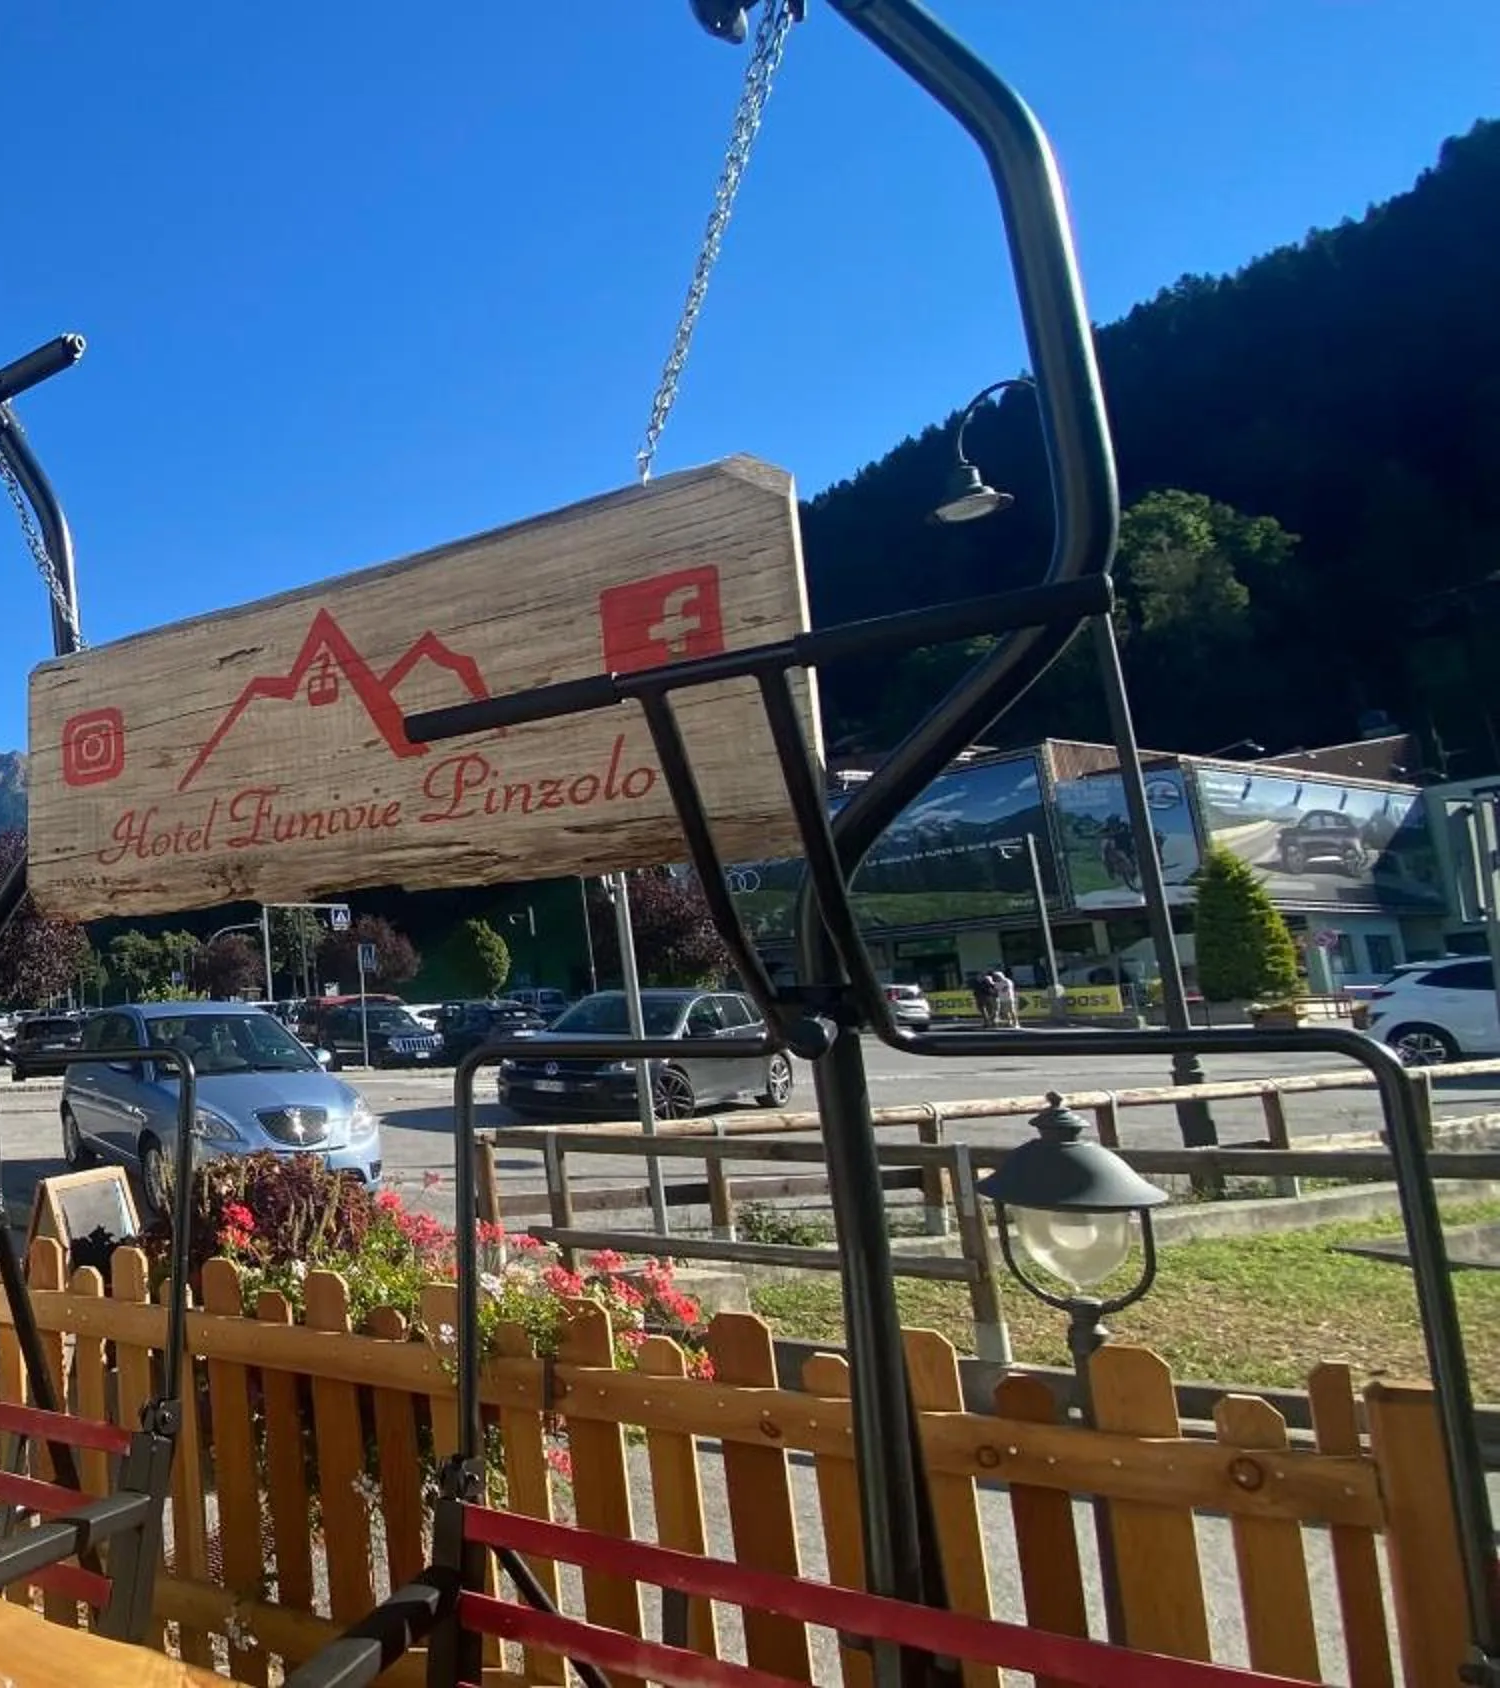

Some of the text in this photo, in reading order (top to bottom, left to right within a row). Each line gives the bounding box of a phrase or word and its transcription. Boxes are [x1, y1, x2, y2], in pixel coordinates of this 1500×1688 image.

[96, 734, 657, 865] Hotel Funivie Pinzolo
